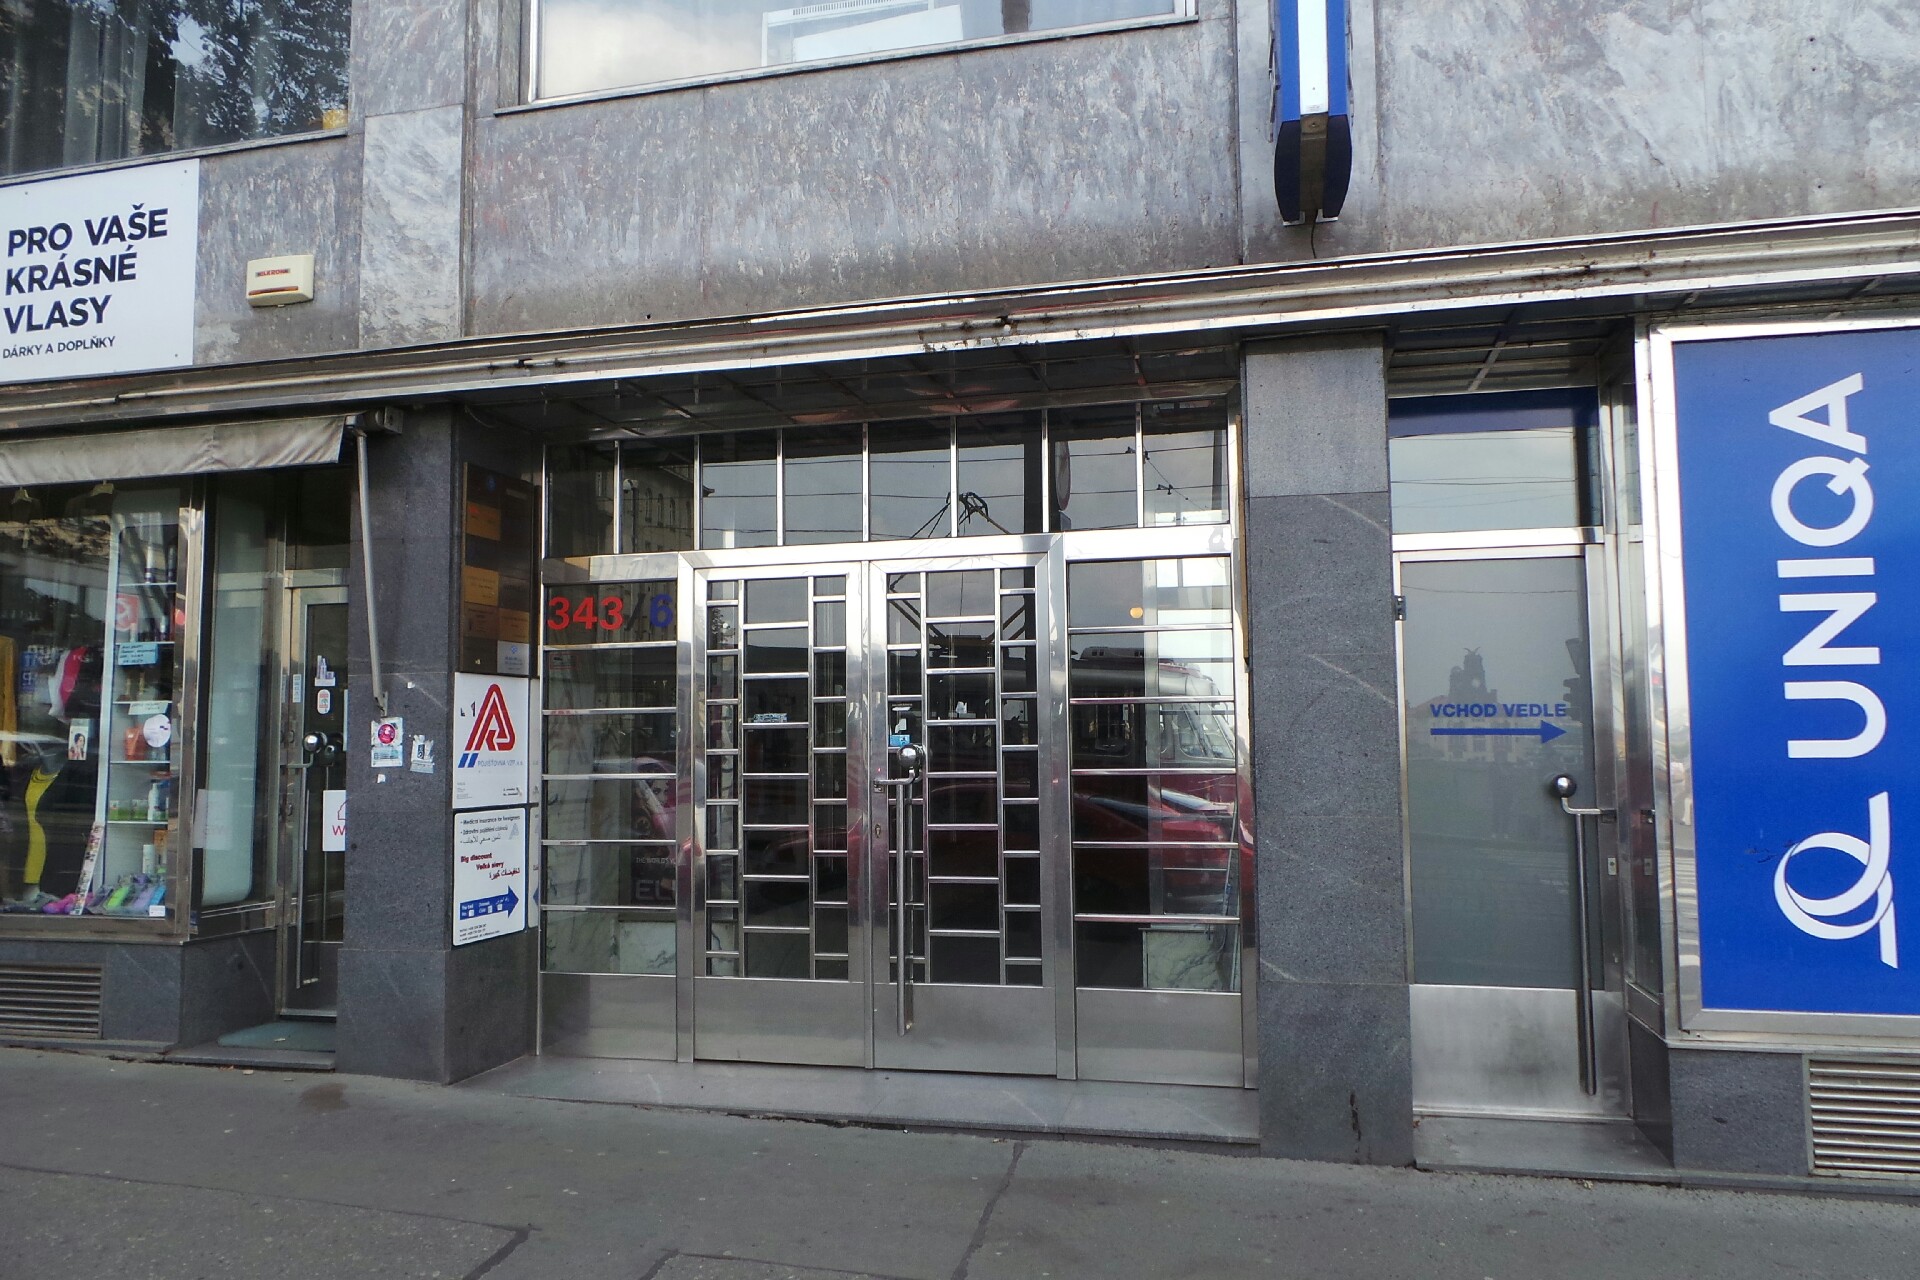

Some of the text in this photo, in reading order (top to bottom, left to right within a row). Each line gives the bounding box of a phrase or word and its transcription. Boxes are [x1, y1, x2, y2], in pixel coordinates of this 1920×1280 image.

[8, 202, 169, 258] PRO VAŠE
[5, 244, 138, 296] KRÁSNÉ
[3, 294, 112, 335] VLASY
[3, 335, 116, 359] DÁRKY A DOPLŇKY
[1768, 371, 1887, 759] UNIQA
[1430, 703, 1567, 718] VCHOD VEDLE
[461, 852, 492, 863] Big discount
